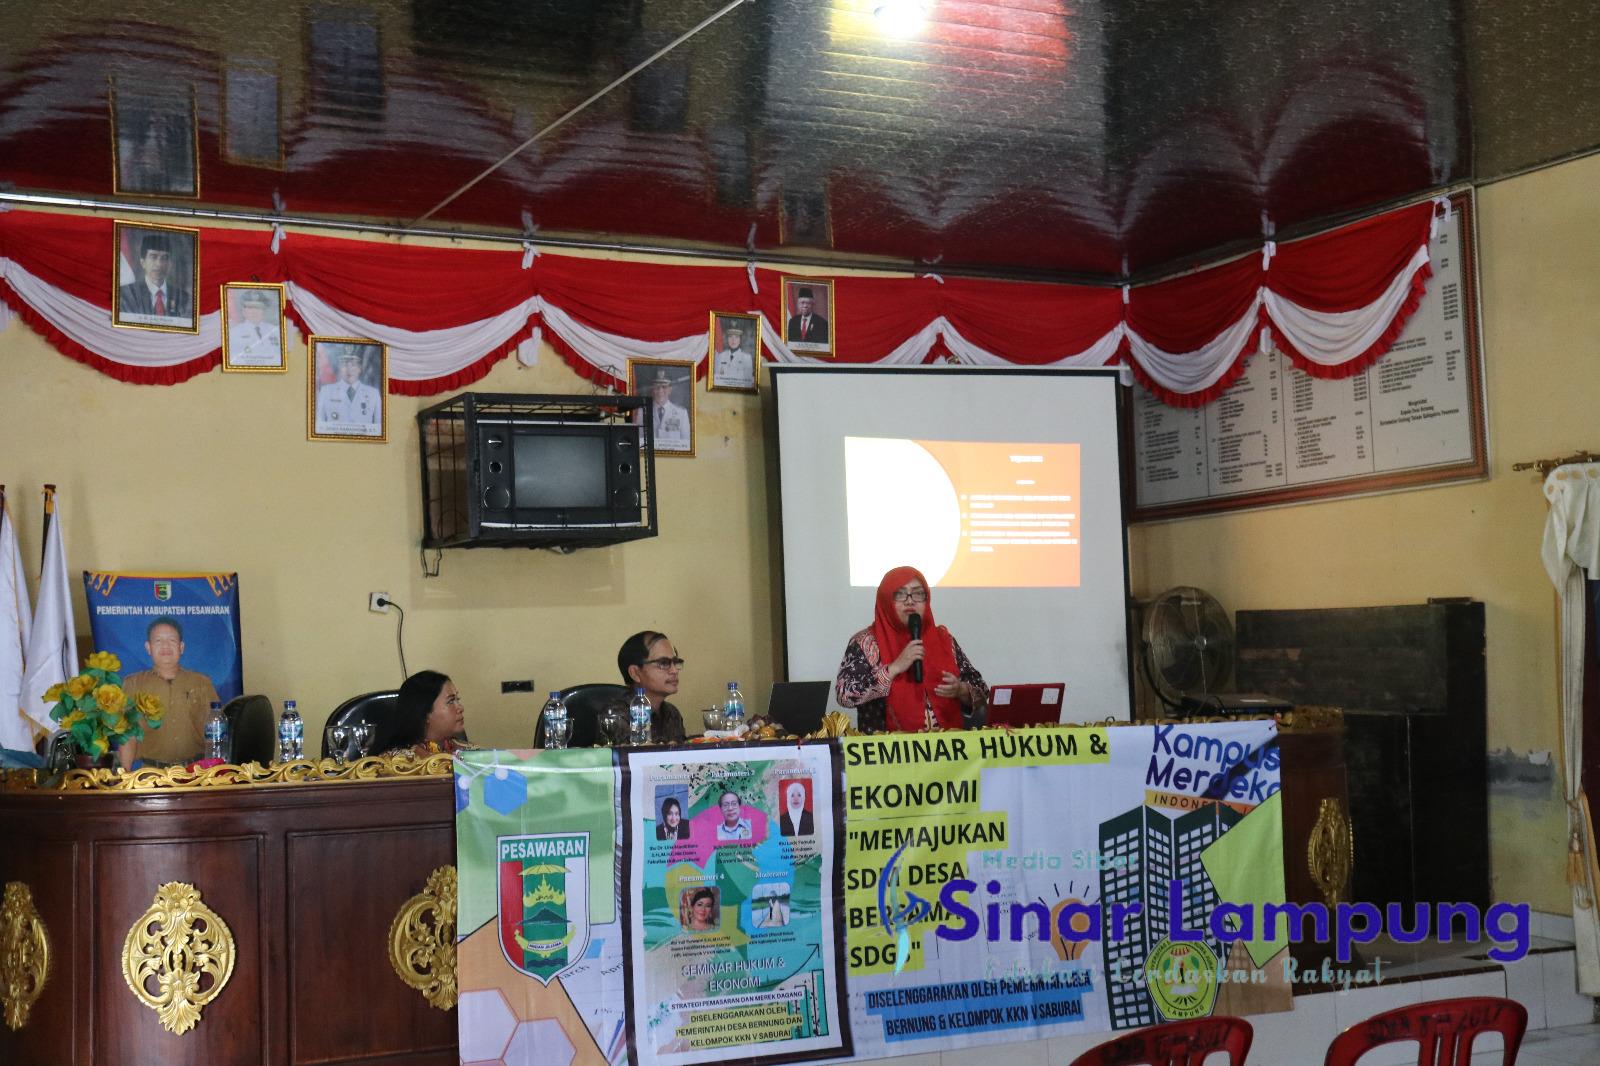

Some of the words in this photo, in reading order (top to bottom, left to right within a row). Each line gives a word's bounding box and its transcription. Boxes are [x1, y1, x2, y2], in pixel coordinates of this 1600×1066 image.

[97, 605, 143, 615] PEMERINTAH
[144, 605, 186, 615] KABUPATEN
[187, 605, 231, 615] PESAWARAN
[847, 738, 968, 766] SEMINAR
[979, 734, 1078, 759] HUKUM
[1090, 733, 1108, 755] &
[1153, 724, 1280, 773] Kampus
[850, 780, 977, 810] EKONOMI
[849, 821, 1005, 852] "MEMAJUKAN
[501, 839, 584, 860] PESAWARAN
[908, 861, 966, 886] DESA
[681, 961, 733, 977] SEMINAR
[735, 958, 775, 972] HUKUM
[777, 957, 785, 967] &
[708, 976, 761, 992] EKONOMI
[868, 986, 969, 1009] DISELENGGARAKAN
[971, 980, 998, 998] OLEH
[671, 1001, 702, 1010] STRATEGI
[702, 997, 740, 1007] PEMASARAN
[754, 994, 776, 1002] MEREK
[776, 991, 803, 1000] DAGANG
[690, 1008, 765, 1023] DISELENGGARAKAN
[766, 1006, 787, 1015] OLEH
[886, 1017, 937, 1036] BERNUNG
[939, 1015, 946, 1030] &
[948, 1010, 1004, 1029] KELOMPOK
[1006, 1006, 1029, 1023] KKN
[1031, 1005, 1038, 1020] V
[1039, 999, 1082, 1018] SABURAI
[675, 1025, 726, 1037] PEMERINTAH
[727, 1022, 747, 1031] DESA
[748, 1019, 784, 1029] BERNUNG
[786, 1016, 803, 1025] DAN
[690, 1035, 733, 1047] KELOMPOK
[734, 1034, 751, 1042] KKN
[752, 1033, 758, 1041] V
[758, 1030, 791, 1040] SABURAI
